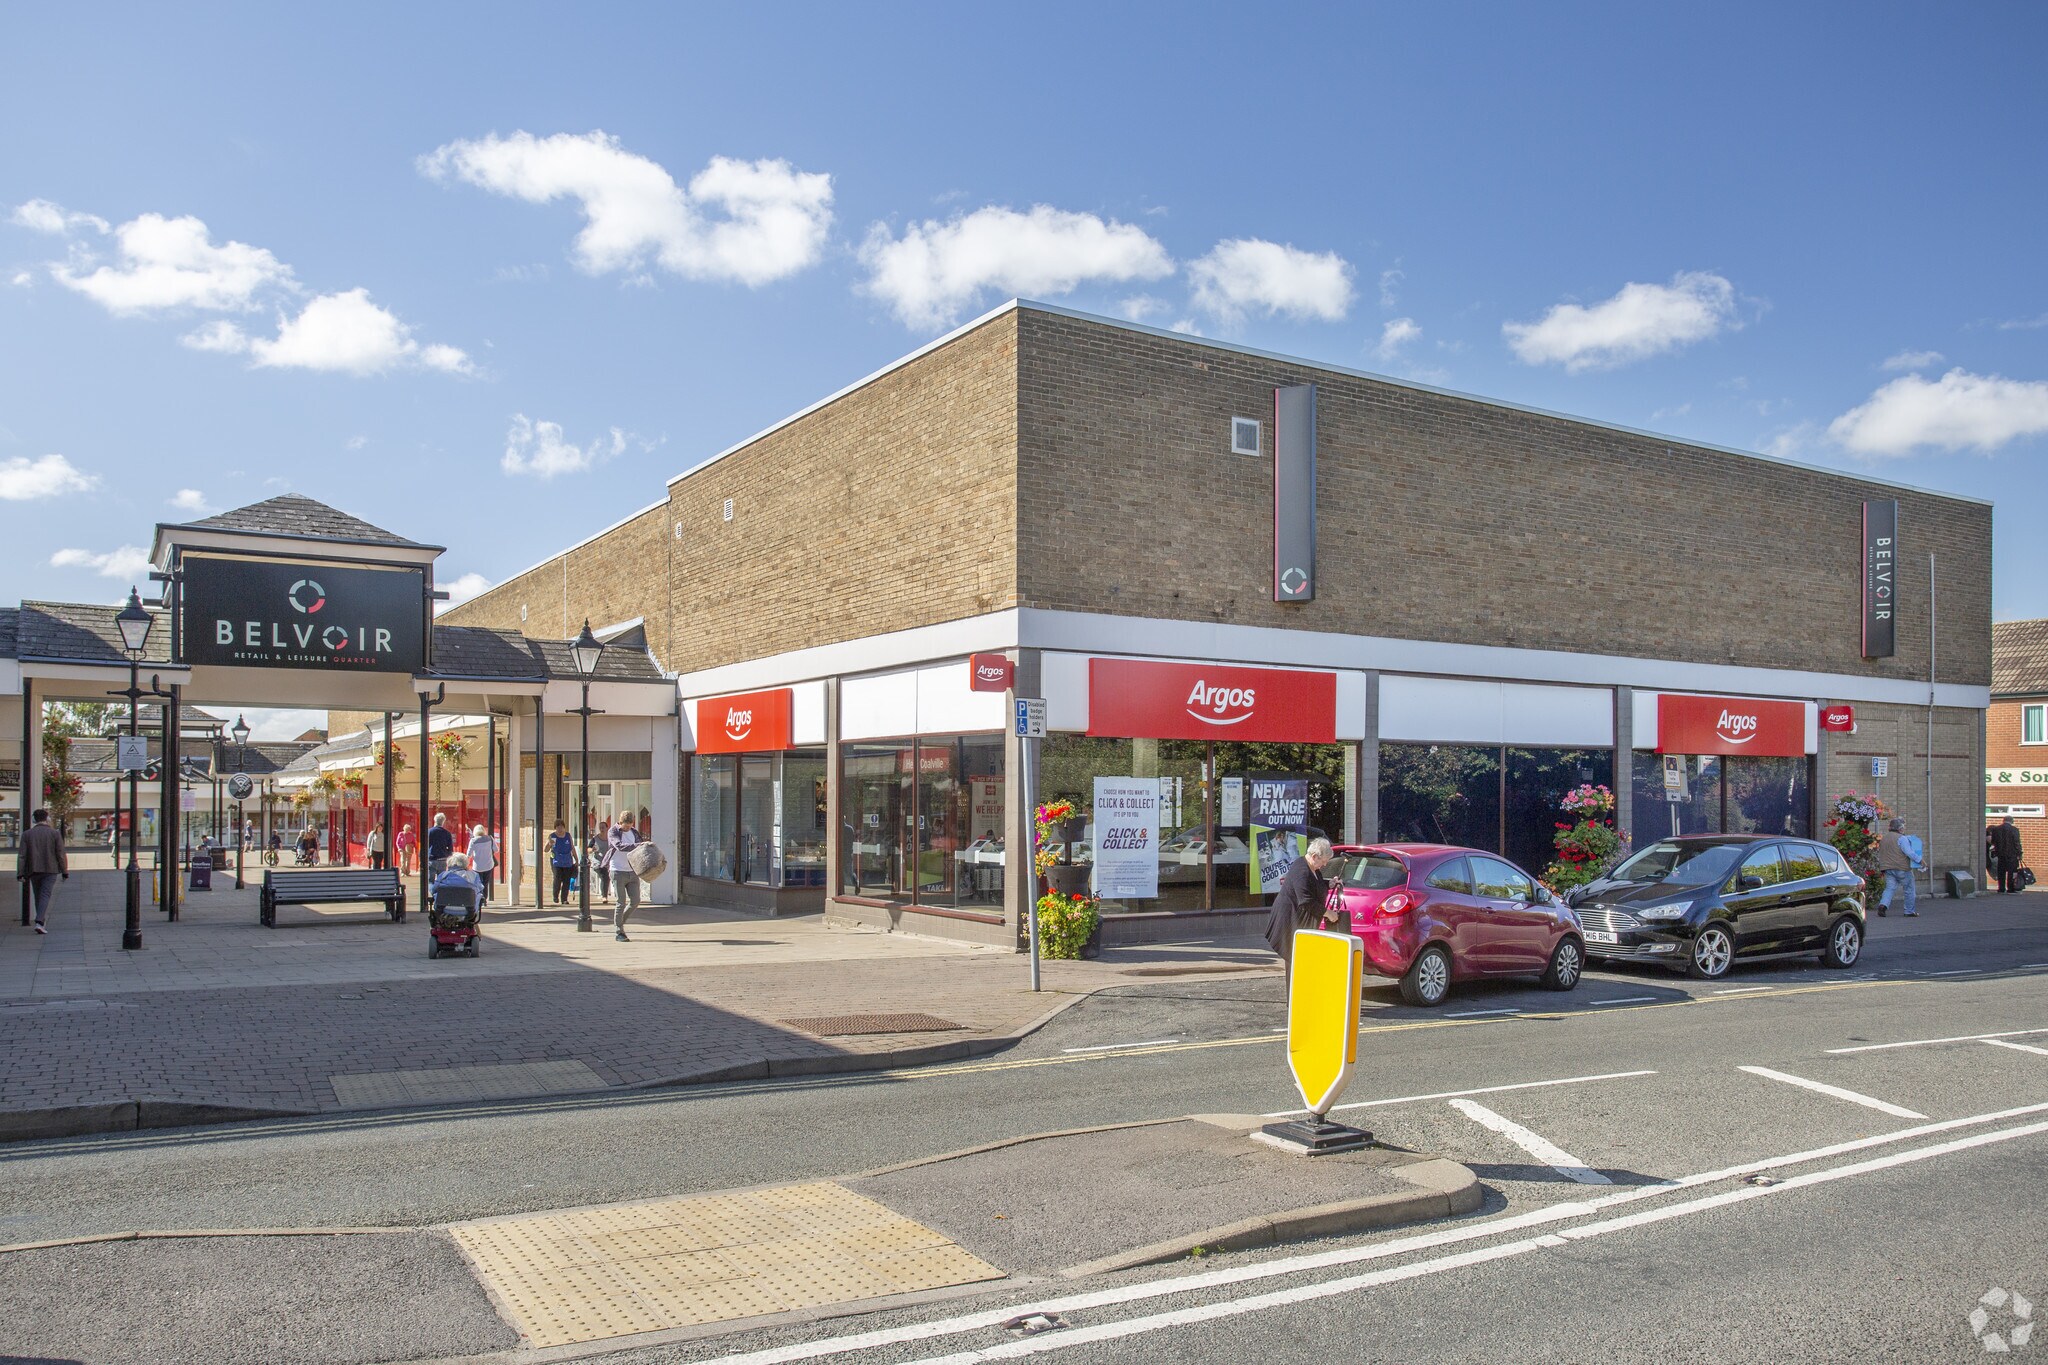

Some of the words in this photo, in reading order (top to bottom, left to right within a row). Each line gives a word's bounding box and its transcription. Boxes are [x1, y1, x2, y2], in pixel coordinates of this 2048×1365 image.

[1876, 538, 1891, 620] BELVOIR
[216, 619, 392, 653] BELVOIR
[234, 652, 269, 660] RETAIL
[288, 654, 327, 662] LEISURE
[333, 656, 377, 664] QUARTER
[977, 665, 1004, 677] Argos
[1187, 680, 1256, 713] Argos
[725, 707, 752, 731] Argos
[1716, 709, 1757, 735] Argos
[1828, 713, 1849, 722] Argos
[920, 758, 944, 769] Coalville
[1998, 771, 2012, 783] &
[1252, 783, 1286, 799] NEW
[1098, 797, 1118, 809] CLICK
[1119, 798, 1125, 809] &
[1126, 798, 1155, 809] COLLECT
[1260, 799, 1306, 815] RANGE
[976, 805, 985, 814] WE
[1268, 815, 1284, 825] OUT
[1284, 815, 1304, 825] NOW
[1107, 828, 1139, 839] CLICK
[1139, 828, 1148, 839] &
[1103, 839, 1149, 850] COLLECT
[1261, 870, 1279, 883] GOOD
[1279, 865, 1287, 875] TO
[1598, 932, 1613, 942] BHL
